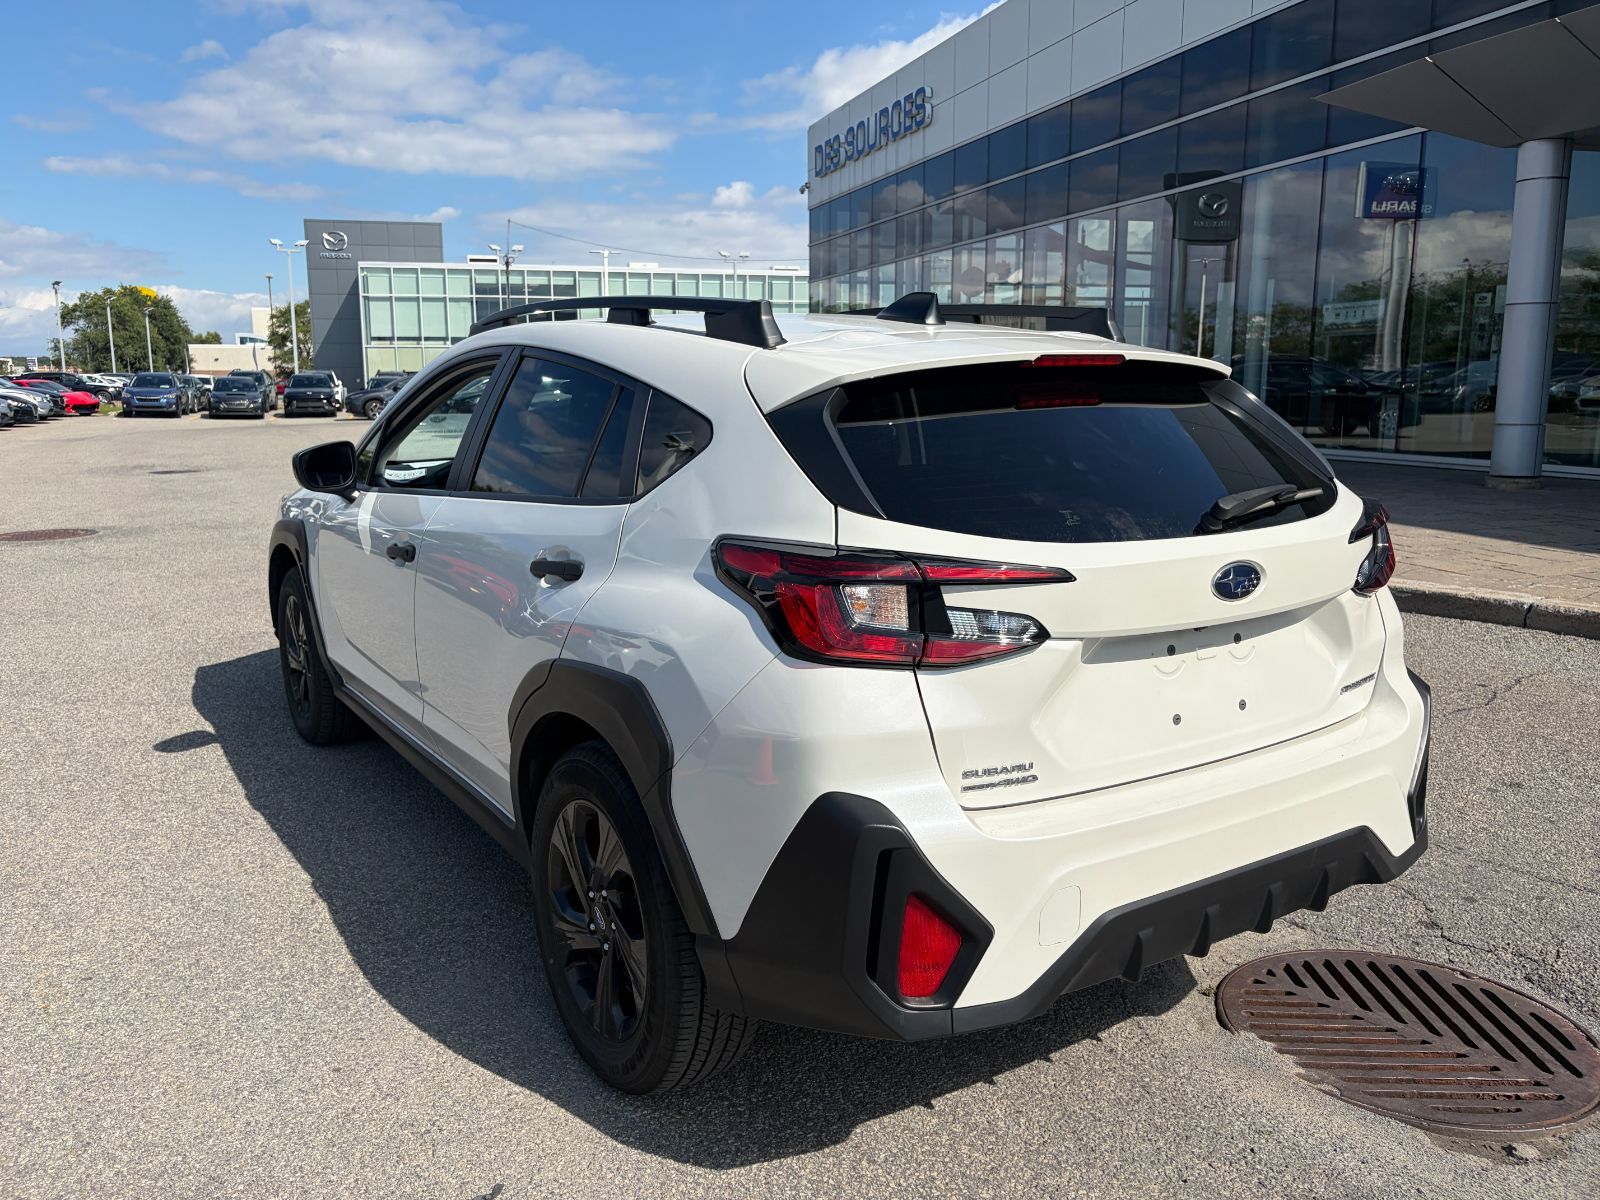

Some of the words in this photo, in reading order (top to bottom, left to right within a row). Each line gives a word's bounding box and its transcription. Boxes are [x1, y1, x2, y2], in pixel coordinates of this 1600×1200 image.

[815, 133, 845, 178] DES
[845, 86, 933, 161] SOURCES
[962, 762, 1034, 779] SUBARU
